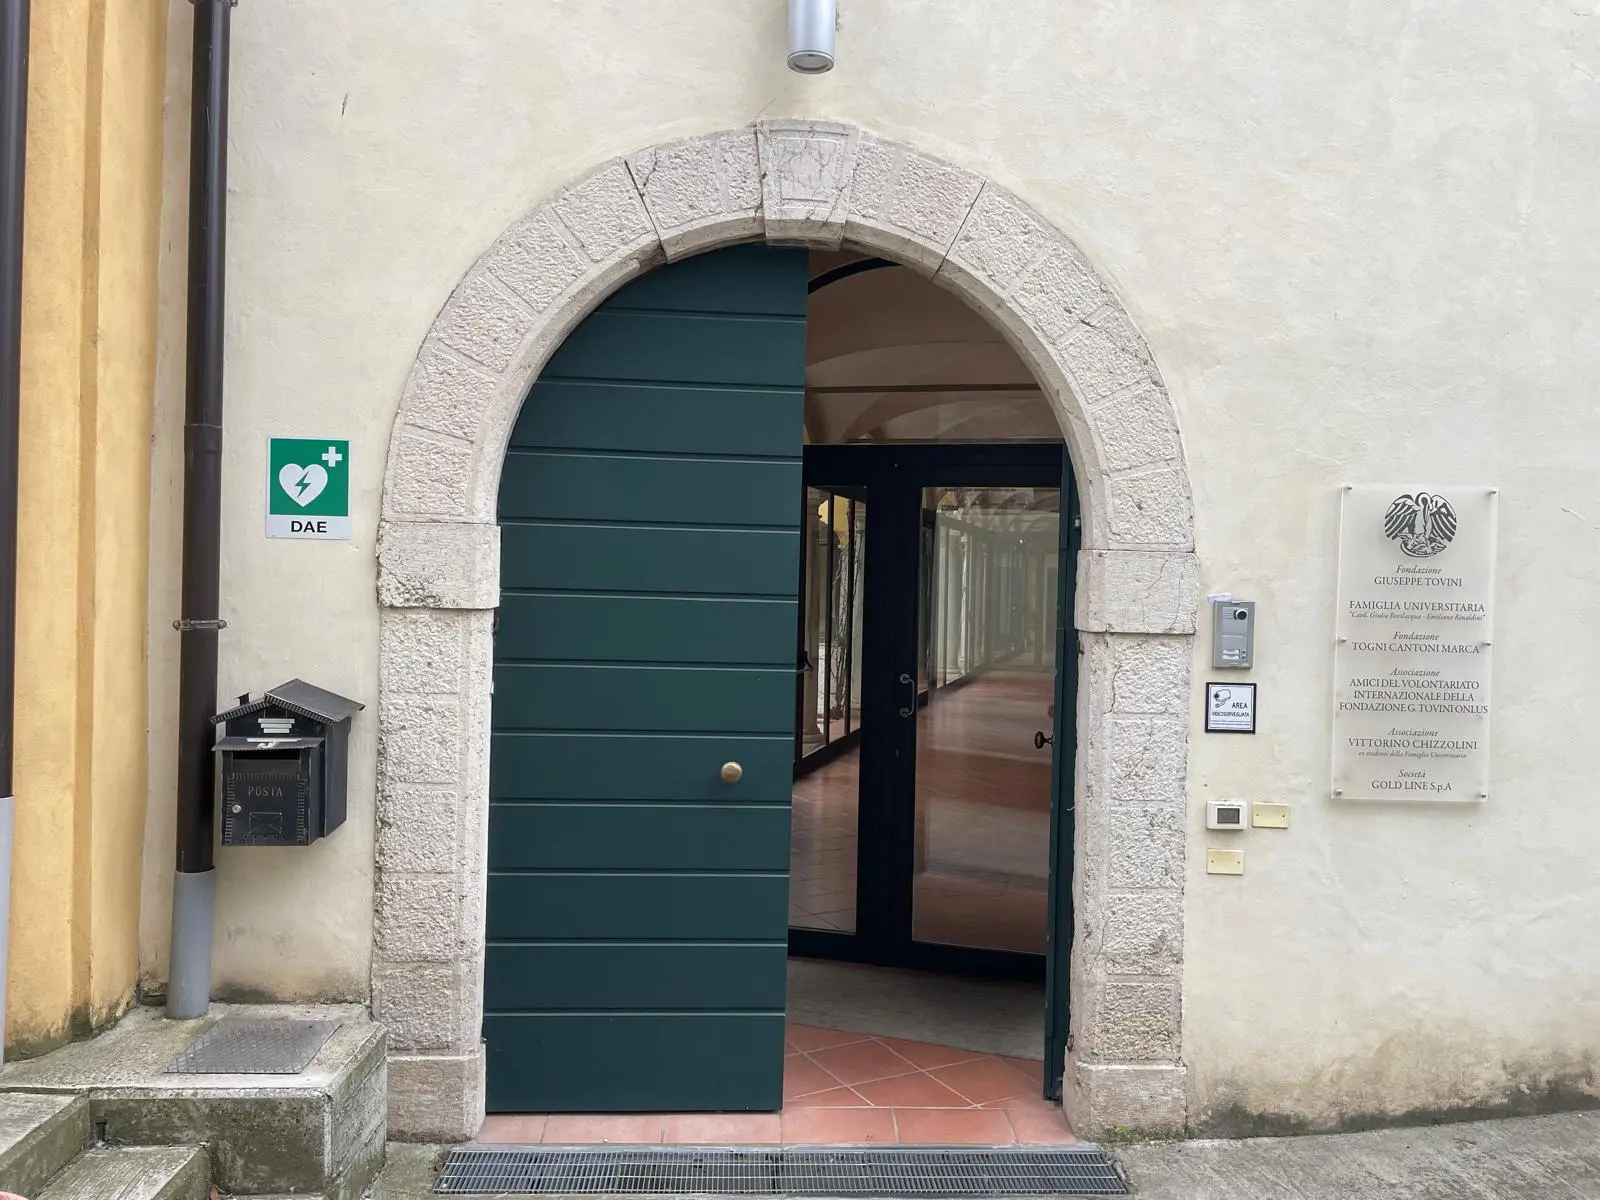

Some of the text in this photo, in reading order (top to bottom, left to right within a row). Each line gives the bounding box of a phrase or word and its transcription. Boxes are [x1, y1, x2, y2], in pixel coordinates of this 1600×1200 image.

[291, 520, 328, 533] DAE
[1396, 565, 1442, 574] Fondazione
[1374, 576, 1462, 587] GIUSEPPE TOVINI
[1349, 600, 1485, 612] FAMIGLIA UNIVERSITARIA
[1393, 631, 1440, 641] Fondazione
[1352, 642, 1480, 654] TOGNI CANTONI MARCA
[1390, 667, 1441, 677] Associazione
[1350, 678, 1480, 690] AMICI DEL VOLONTARIATO
[1354, 690, 1475, 702] INTERNAZIONALE DELLA
[1339, 701, 1488, 714] FONDAZIONE G. TOVINI ONLUS
[1388, 727, 1439, 737] Associazione
[1349, 738, 1478, 750] VITTORINO CHIZZOLINI
[1404, 751, 1429, 759] Famiglia
[1398, 769, 1426, 778] Società
[248, 785, 283, 798] POSTA
[1371, 780, 1452, 793] GOLD LINE S.p.A
